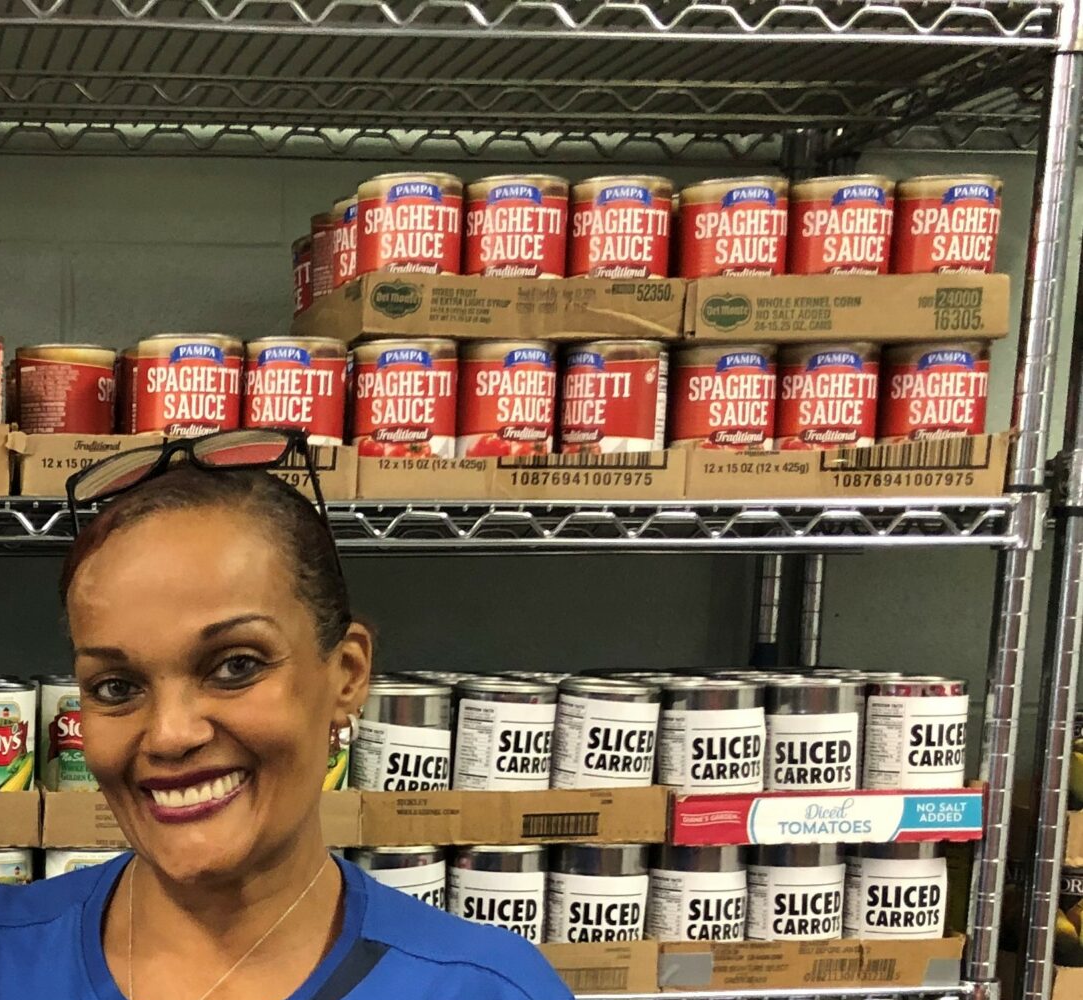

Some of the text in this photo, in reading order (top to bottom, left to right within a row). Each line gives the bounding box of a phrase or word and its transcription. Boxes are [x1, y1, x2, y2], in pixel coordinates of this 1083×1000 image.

[395, 184, 435, 197] PAMPA
[494, 186, 534, 199] PAMPA
[605, 187, 644, 199] PAMPA
[732, 188, 770, 201] PAMPA
[842, 186, 879, 199] PAMPA
[953, 186, 989, 199] PAMPA
[364, 204, 459, 236] SPAGHETTI
[467, 206, 561, 237] SPAGHETTI
[573, 205, 668, 238] SPAGHETTI
[380, 232, 445, 259] SAUCE
[480, 233, 544, 261] SAUCE
[588, 235, 654, 262] SAUCE
[715, 237, 778, 264] SAUCE
[822, 236, 885, 262] SAUCE
[931, 235, 993, 262] SAUCE
[756, 296, 862, 308] WHOLE KERNEL CORN
[756, 309, 831, 320] NO SALT ADDED
[178, 346, 218, 358] PAMPA
[264, 349, 302, 361] PAMPA
[385, 350, 424, 364] PAMPA
[513, 350, 547, 363] PAMPA
[726, 353, 761, 366] PAMPA
[817, 353, 856, 365] PAMPA
[927, 352, 967, 365] PAMPA
[146, 366, 239, 395] SPAGHETTI
[357, 370, 452, 399] SPAGHETTI
[163, 394, 226, 421] SAUCE
[250, 397, 313, 423] SAUCE
[371, 398, 435, 425] SAUCE
[497, 398, 551, 423] SAUCE
[709, 401, 768, 427] SAUCE
[799, 400, 863, 426] SAUCE
[908, 398, 974, 425] SAUCE
[376, 428, 428, 441] Traditional
[715, 429, 764, 444] Traditional
[804, 429, 857, 443] Traditional
[41, 458, 79, 468] 12 15
[379, 459, 487, 472] 12 15 OZ (12 425g)
[703, 462, 810, 475] 12 15 OZ (12 425g)
[510, 471, 653, 486] 10876941007975
[833, 471, 974, 487] 10876941007975
[587, 726, 654, 753] SLICED
[692, 734, 762, 761] SLICED
[583, 752, 652, 773] CARROTS
[775, 740, 852, 765] SLICED
[386, 752, 449, 780] SLICED
[691, 759, 761, 781] CARROTS
[774, 765, 852, 784] CARROTS
[804, 798, 855, 819] Diced
[916, 802, 967, 813] NO SALT
[919, 812, 962, 823] ADDED
[778, 819, 872, 836] TOMATOES
[774, 890, 840, 917] SLICED
[867, 885, 941, 908] SLICED
[463, 896, 537, 921] SLICED
[569, 902, 640, 926] SLICED
[865, 909, 940, 928] CARROTS
[567, 926, 639, 943] CARROTS
[772, 916, 840, 936] CARROTS
